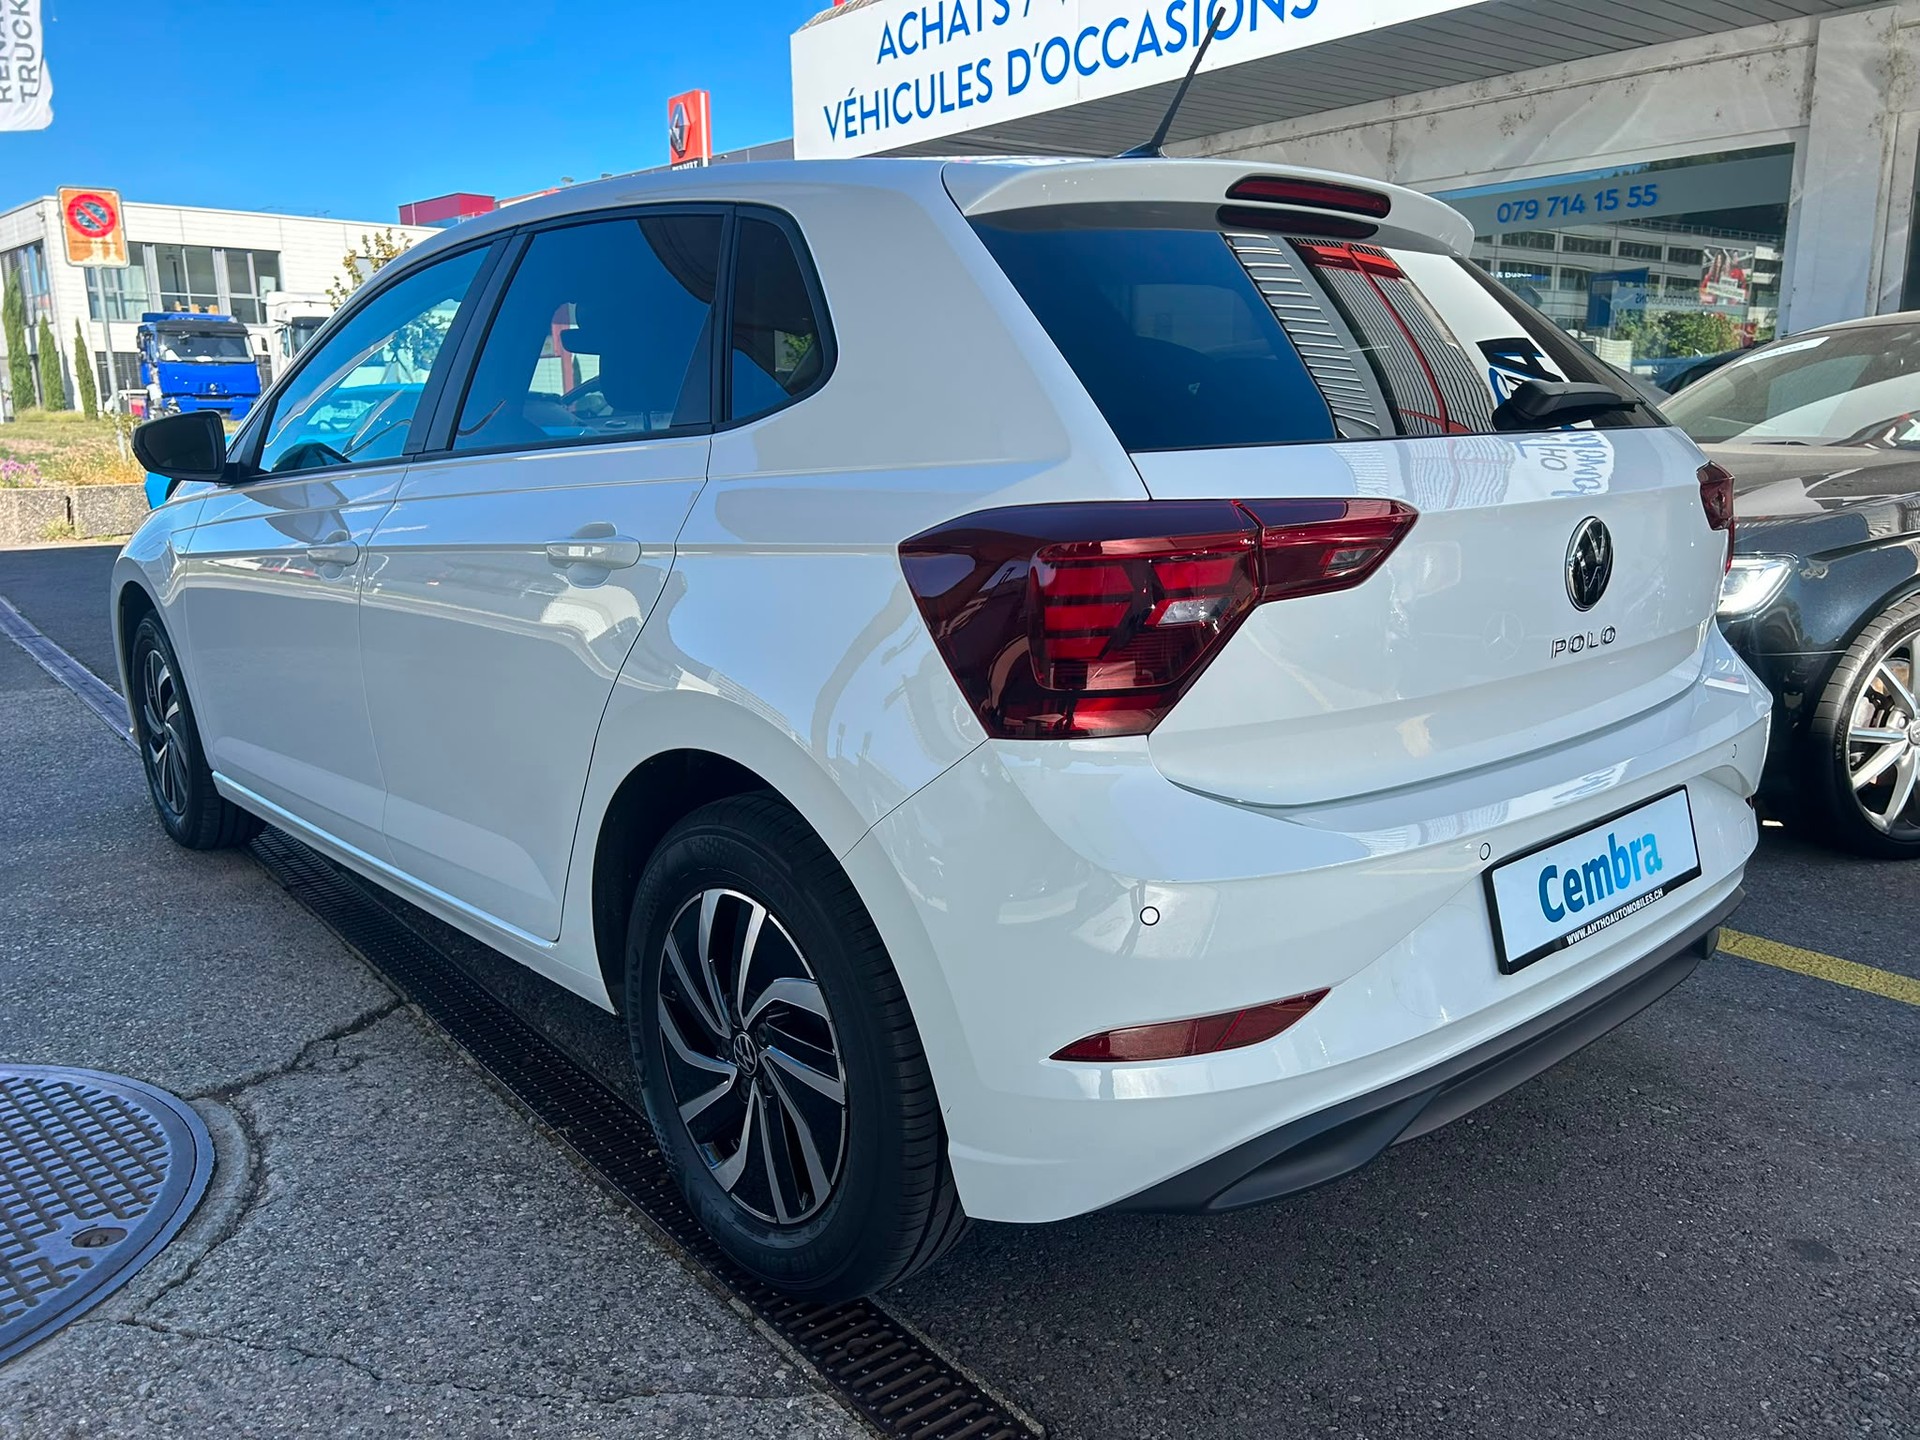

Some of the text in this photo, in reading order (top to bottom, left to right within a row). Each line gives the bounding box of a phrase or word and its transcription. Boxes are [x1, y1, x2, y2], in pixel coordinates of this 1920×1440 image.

[877, 0, 1011, 65] ACHATS
[823, 58, 993, 142] VÉHICULES
[1496, 183, 1660, 224] 079 714 15 55
[1551, 625, 1617, 659] POLO
[1538, 832, 1663, 923] Cembra
[1566, 887, 1664, 946] WWW.ANTHOAUTOMOBILES.CH
